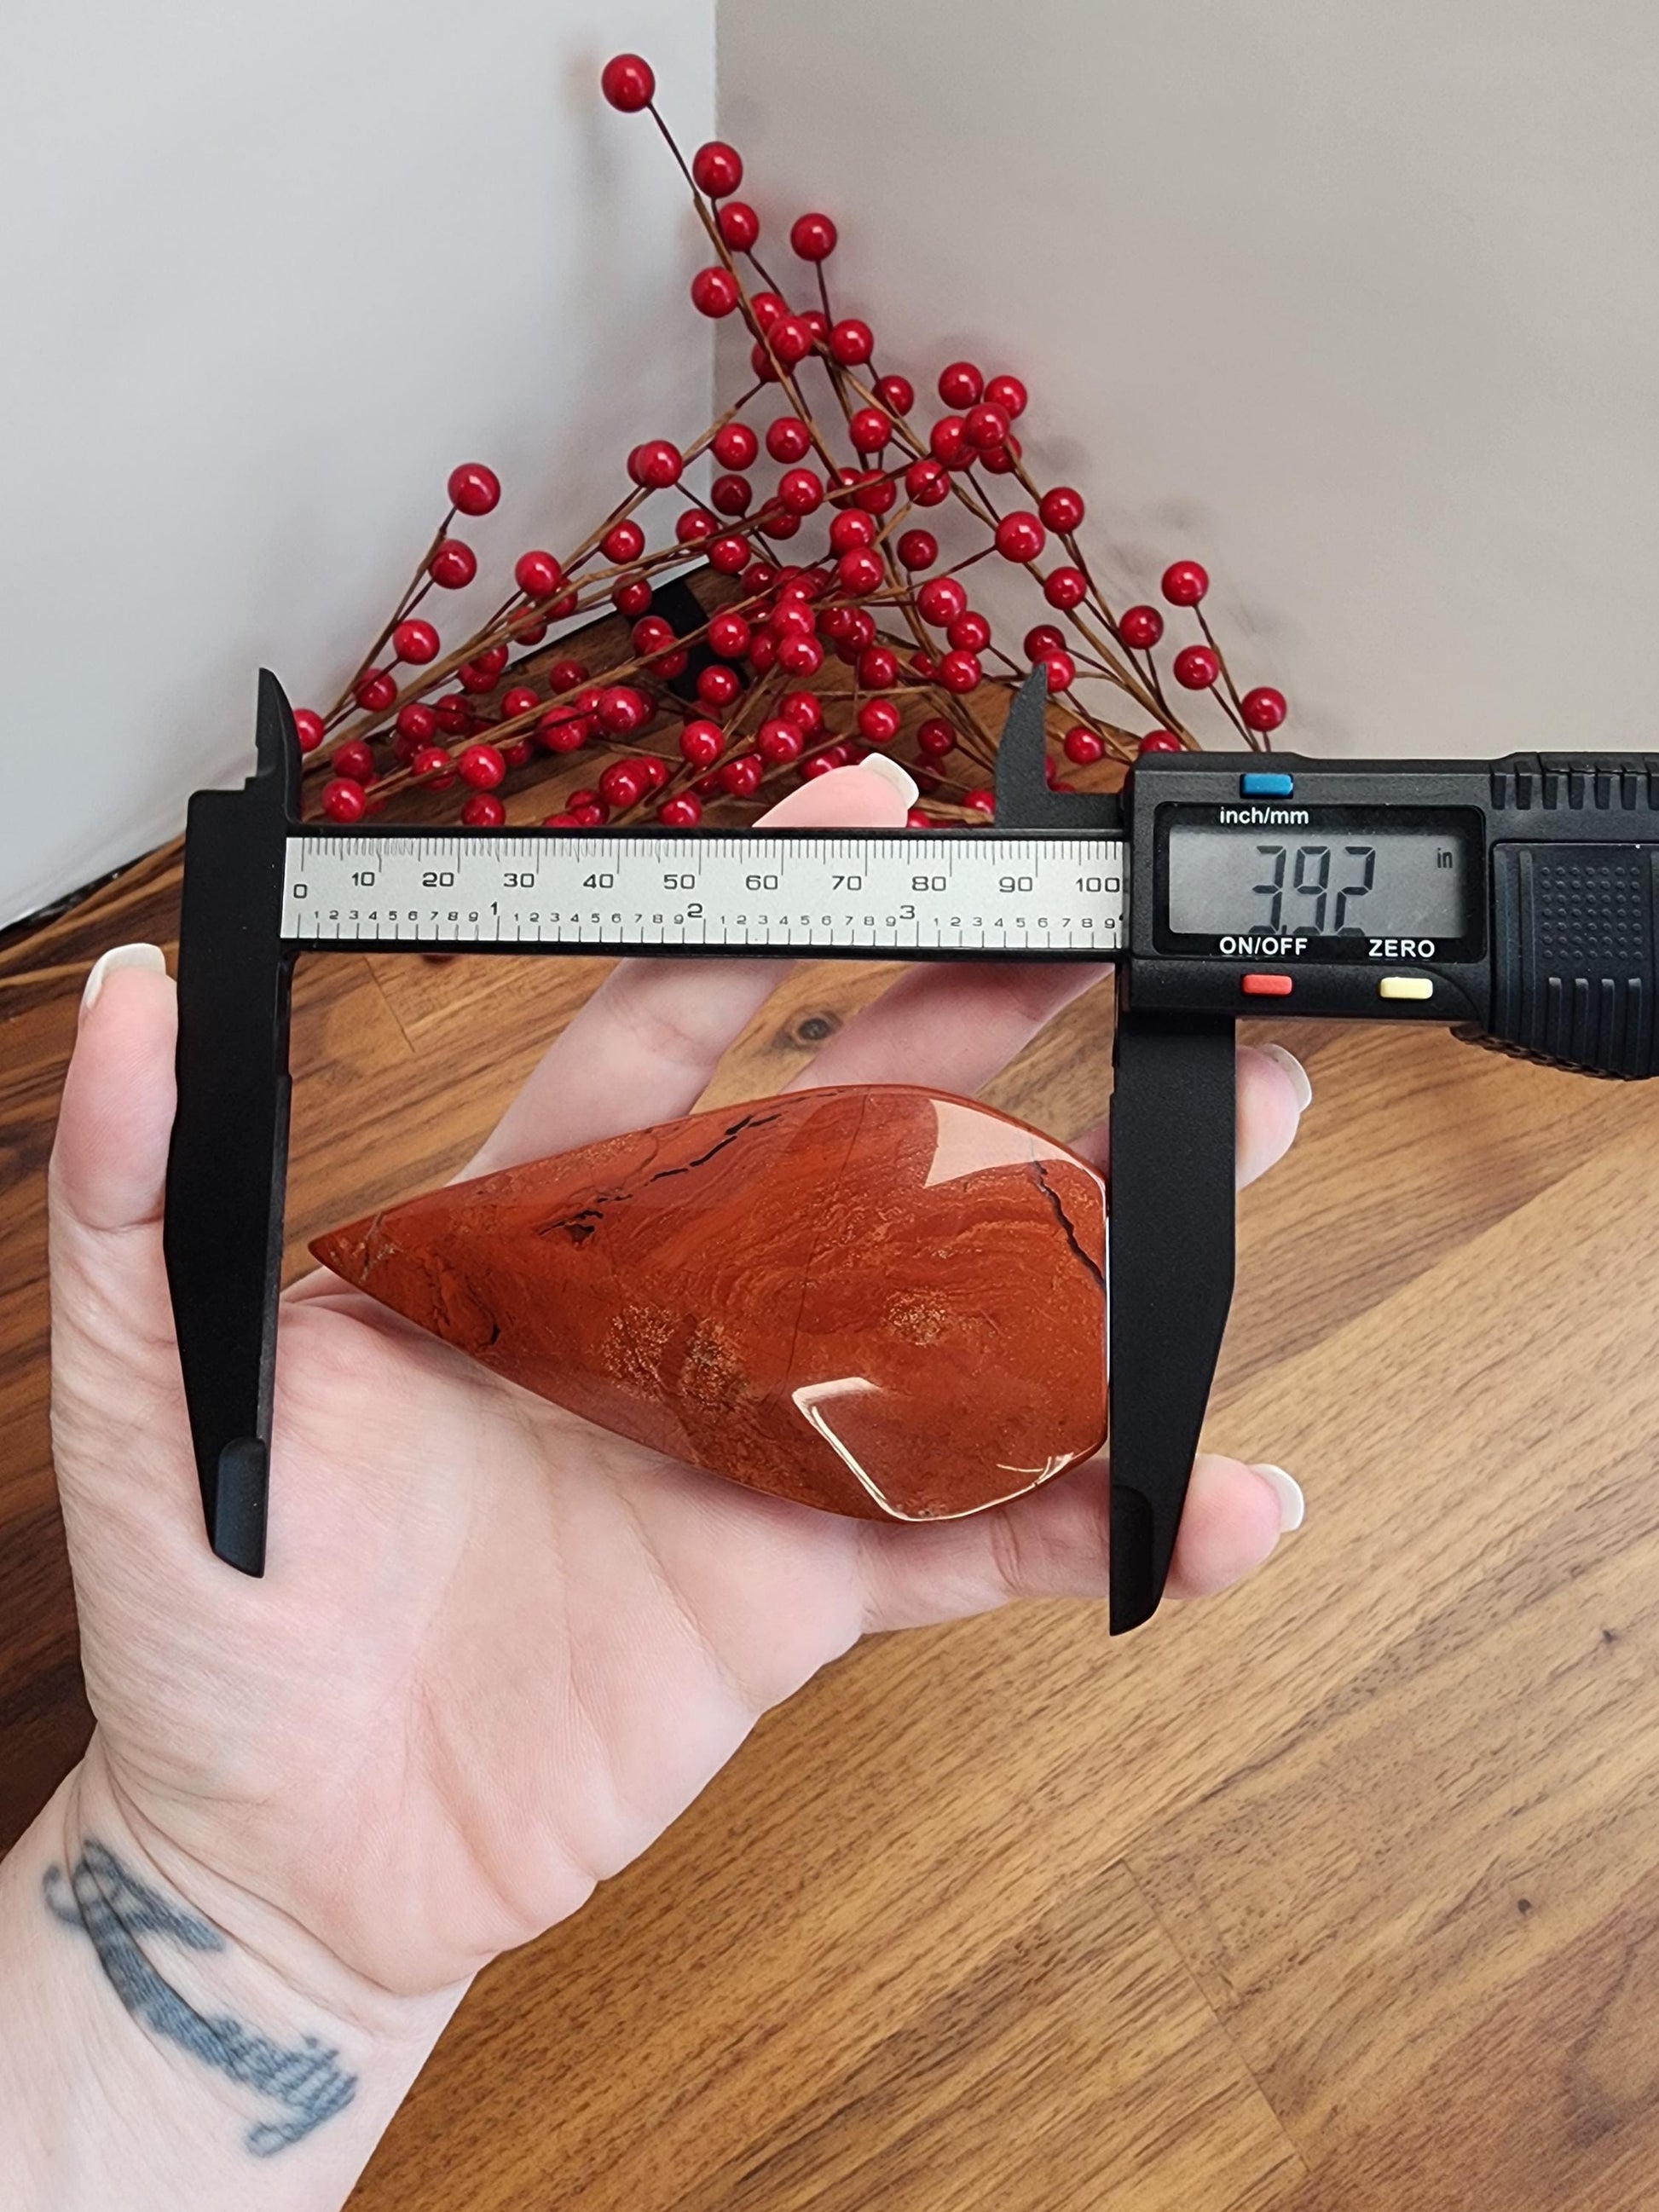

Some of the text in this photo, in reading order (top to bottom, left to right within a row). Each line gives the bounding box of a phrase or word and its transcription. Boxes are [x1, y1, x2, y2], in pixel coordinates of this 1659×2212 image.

[1219, 806, 1309, 825] inch/mm
[1436, 847, 1454, 869] in
[292, 871, 1120, 899] 0 10 20 30 40 50 60 70 80 90 100
[314, 900, 1116, 929] 1 2 3 4 5 6 7 8 9 1 1 2 3 4 5 6 7 8 9 2 1 2 3 4 5 6 7 8 9 3 1 2 3 4 5 6 7 8 9
[1219, 937, 1436, 958] ON/OFF ZERO
